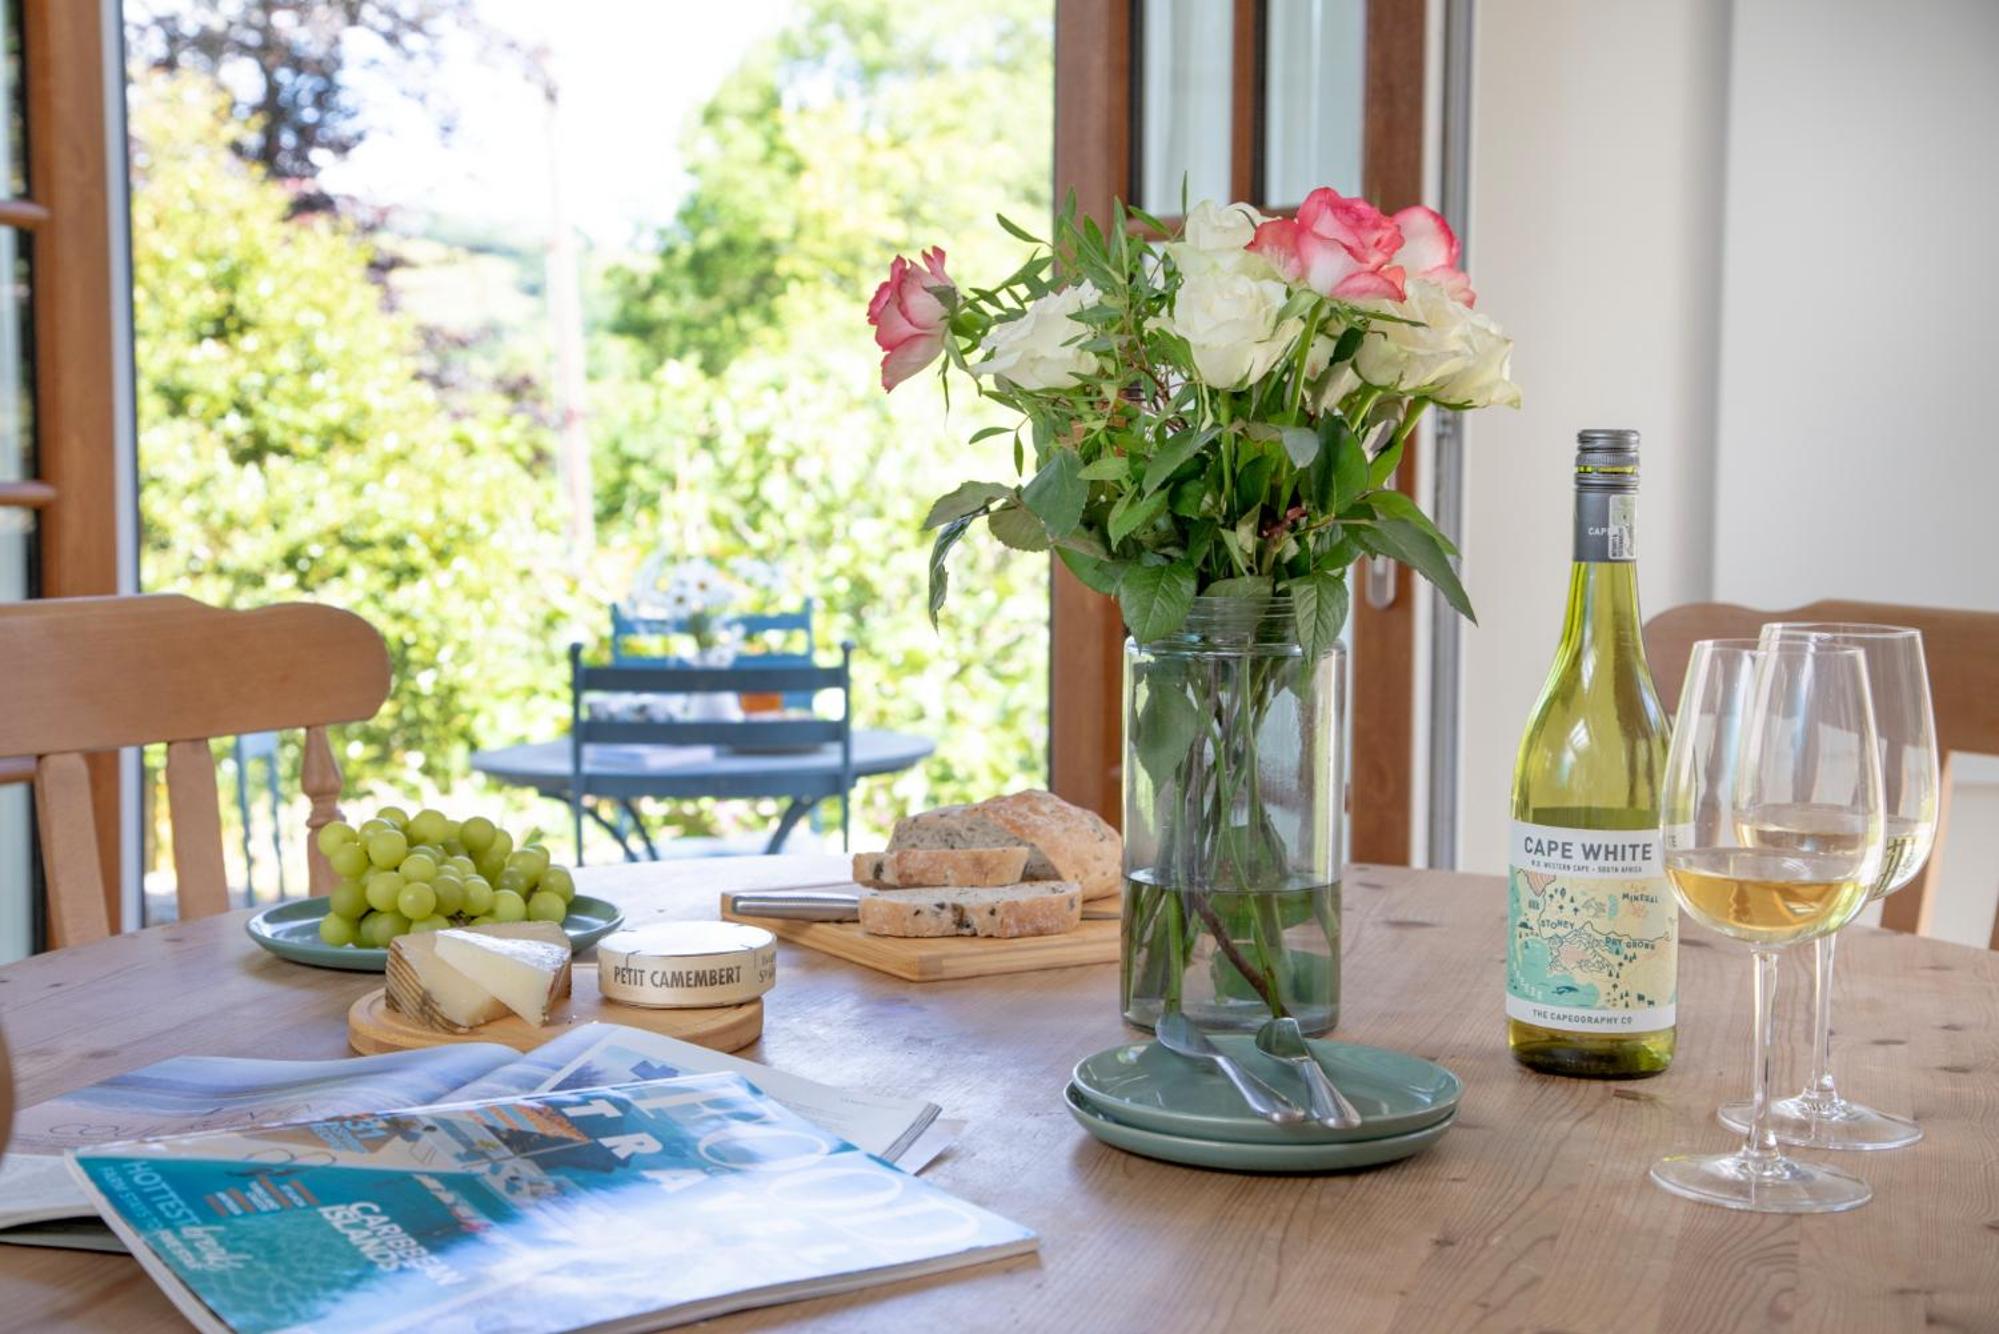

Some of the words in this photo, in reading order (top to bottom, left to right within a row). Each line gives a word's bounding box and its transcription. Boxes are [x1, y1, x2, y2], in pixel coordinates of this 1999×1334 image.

[1524, 836, 1573, 860] CAPE
[1581, 843, 1653, 861] WHITE
[1573, 864, 1589, 873] CAPE
[1540, 919, 1574, 931] STONEY
[614, 966, 646, 987] PETIT
[650, 966, 742, 988] CAMEMBERT
[1533, 1009, 1548, 1019] THE
[1620, 1015, 1633, 1024] CO
[122, 1160, 203, 1226] HOTTEST
[317, 1205, 400, 1271] ISLANDS
[349, 1202, 466, 1286] CARIBBEAN
